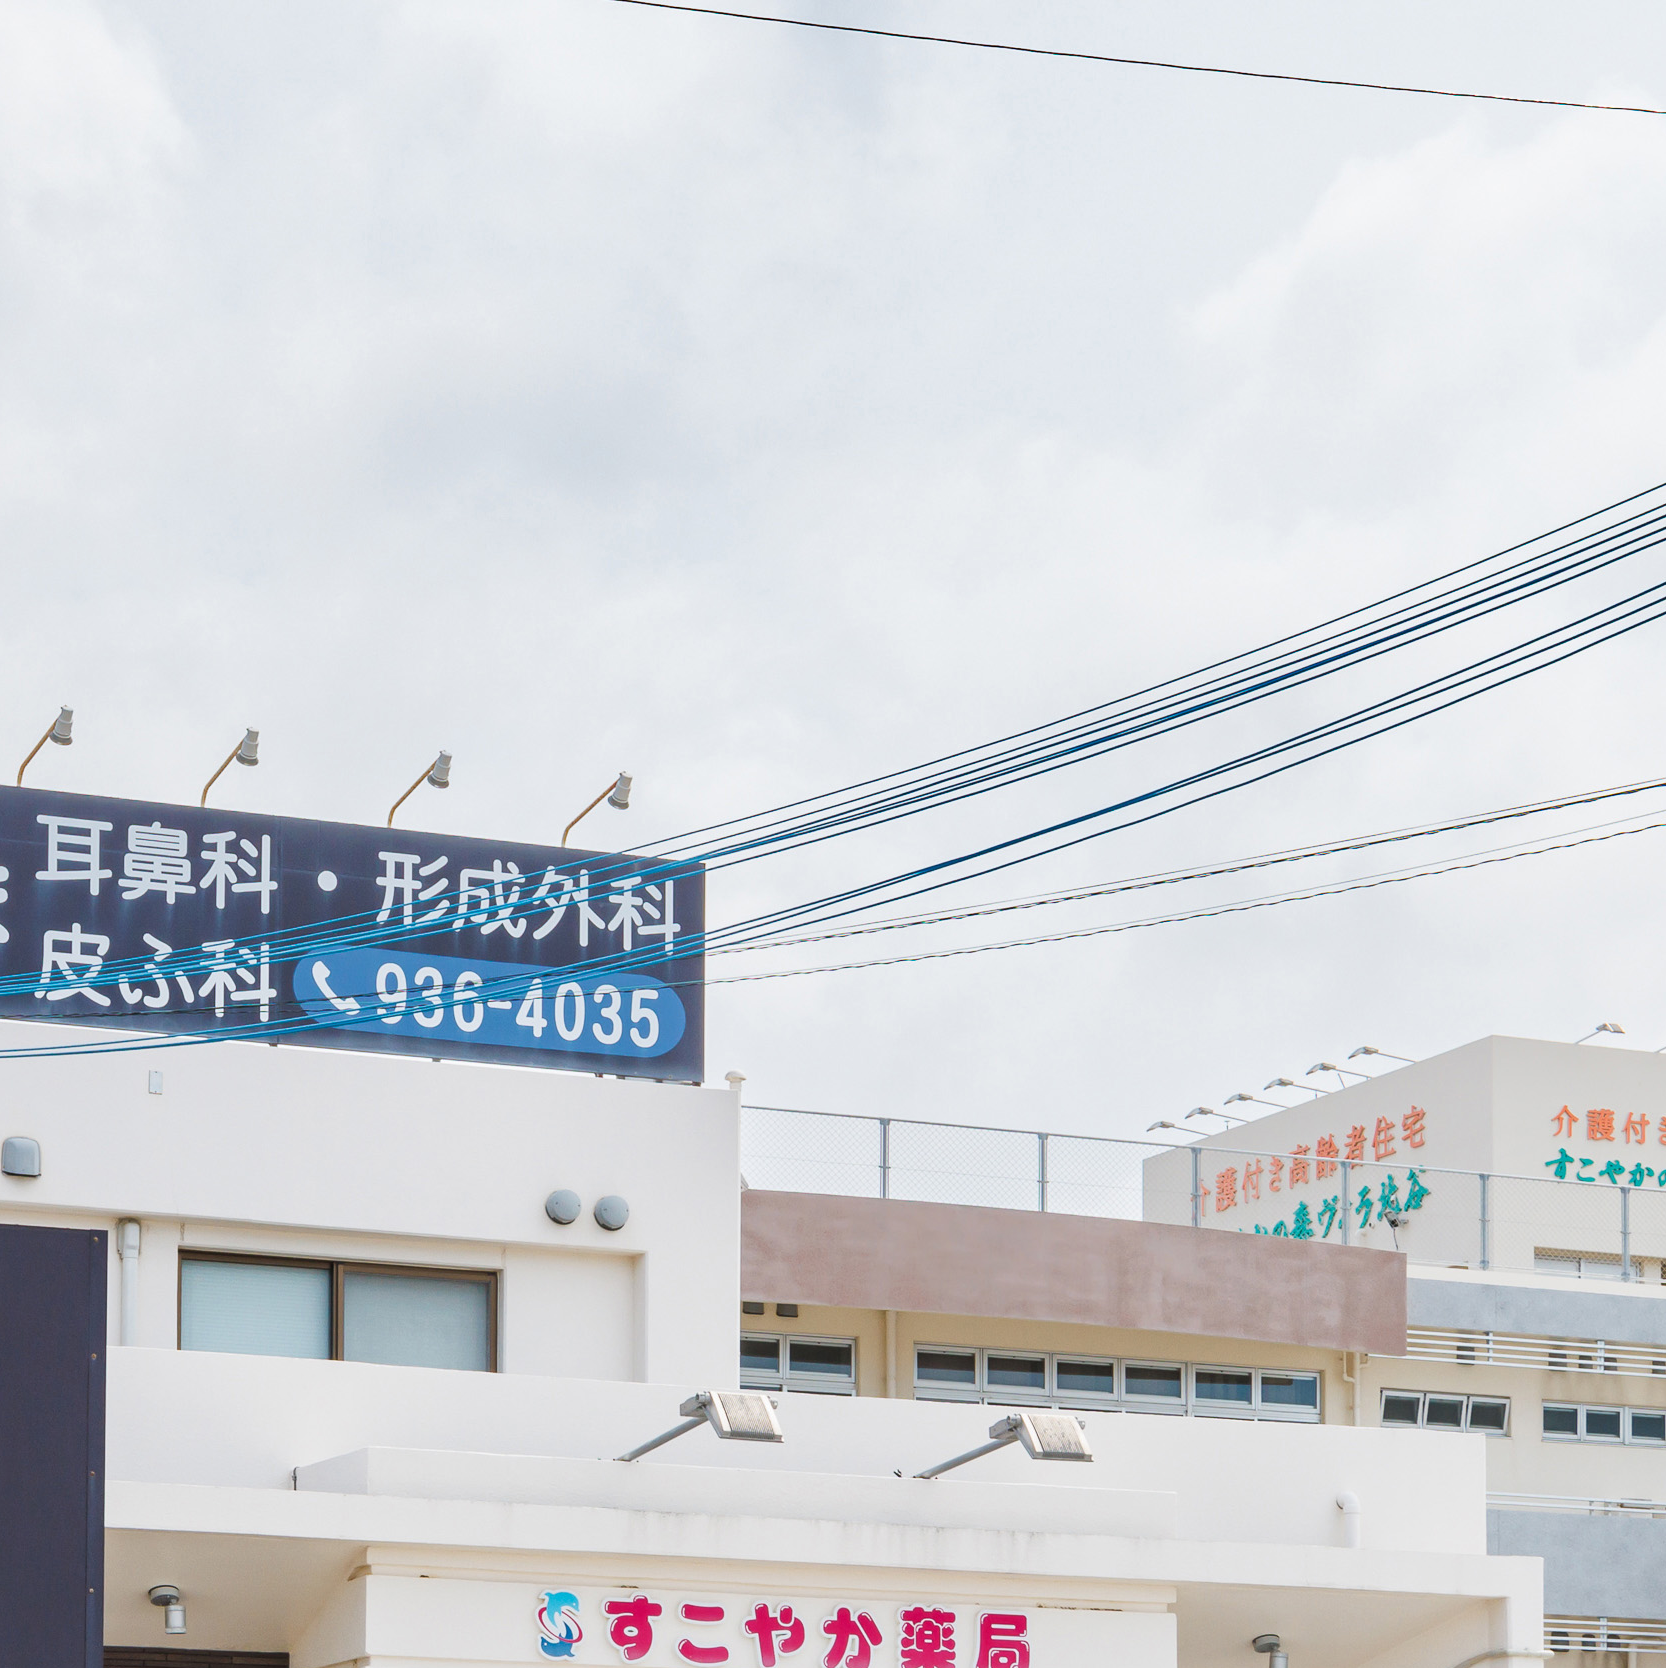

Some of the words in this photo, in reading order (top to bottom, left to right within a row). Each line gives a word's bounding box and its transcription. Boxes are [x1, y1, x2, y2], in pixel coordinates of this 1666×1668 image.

[35, 813, 681, 956] 耳鼻科・形成外科
[38, 928, 278, 1024] 皮ふ科
[373, 961, 662, 1050] 936-4035
